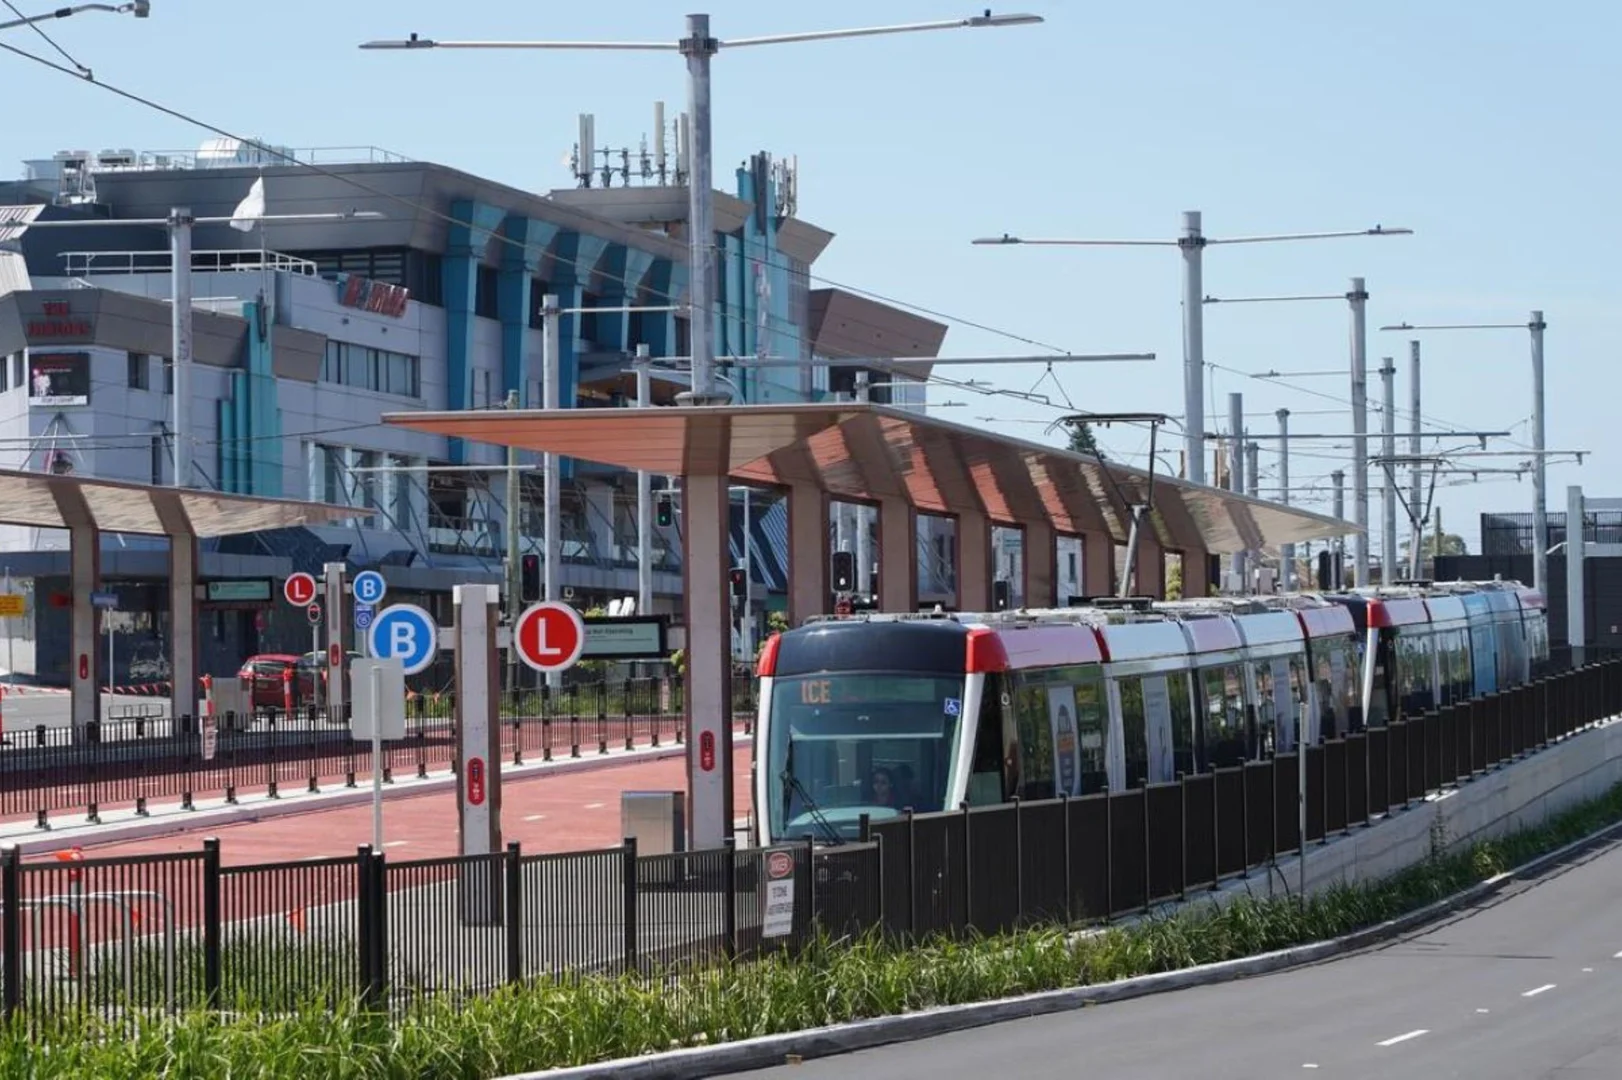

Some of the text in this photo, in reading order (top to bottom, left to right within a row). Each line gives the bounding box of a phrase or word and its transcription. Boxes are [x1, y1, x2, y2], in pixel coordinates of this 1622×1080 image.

[294, 580, 307, 598] L
[362, 579, 376, 598] B
[390, 621, 416, 658] B
[538, 617, 561, 655] L
[801, 680, 832, 704] ICE
